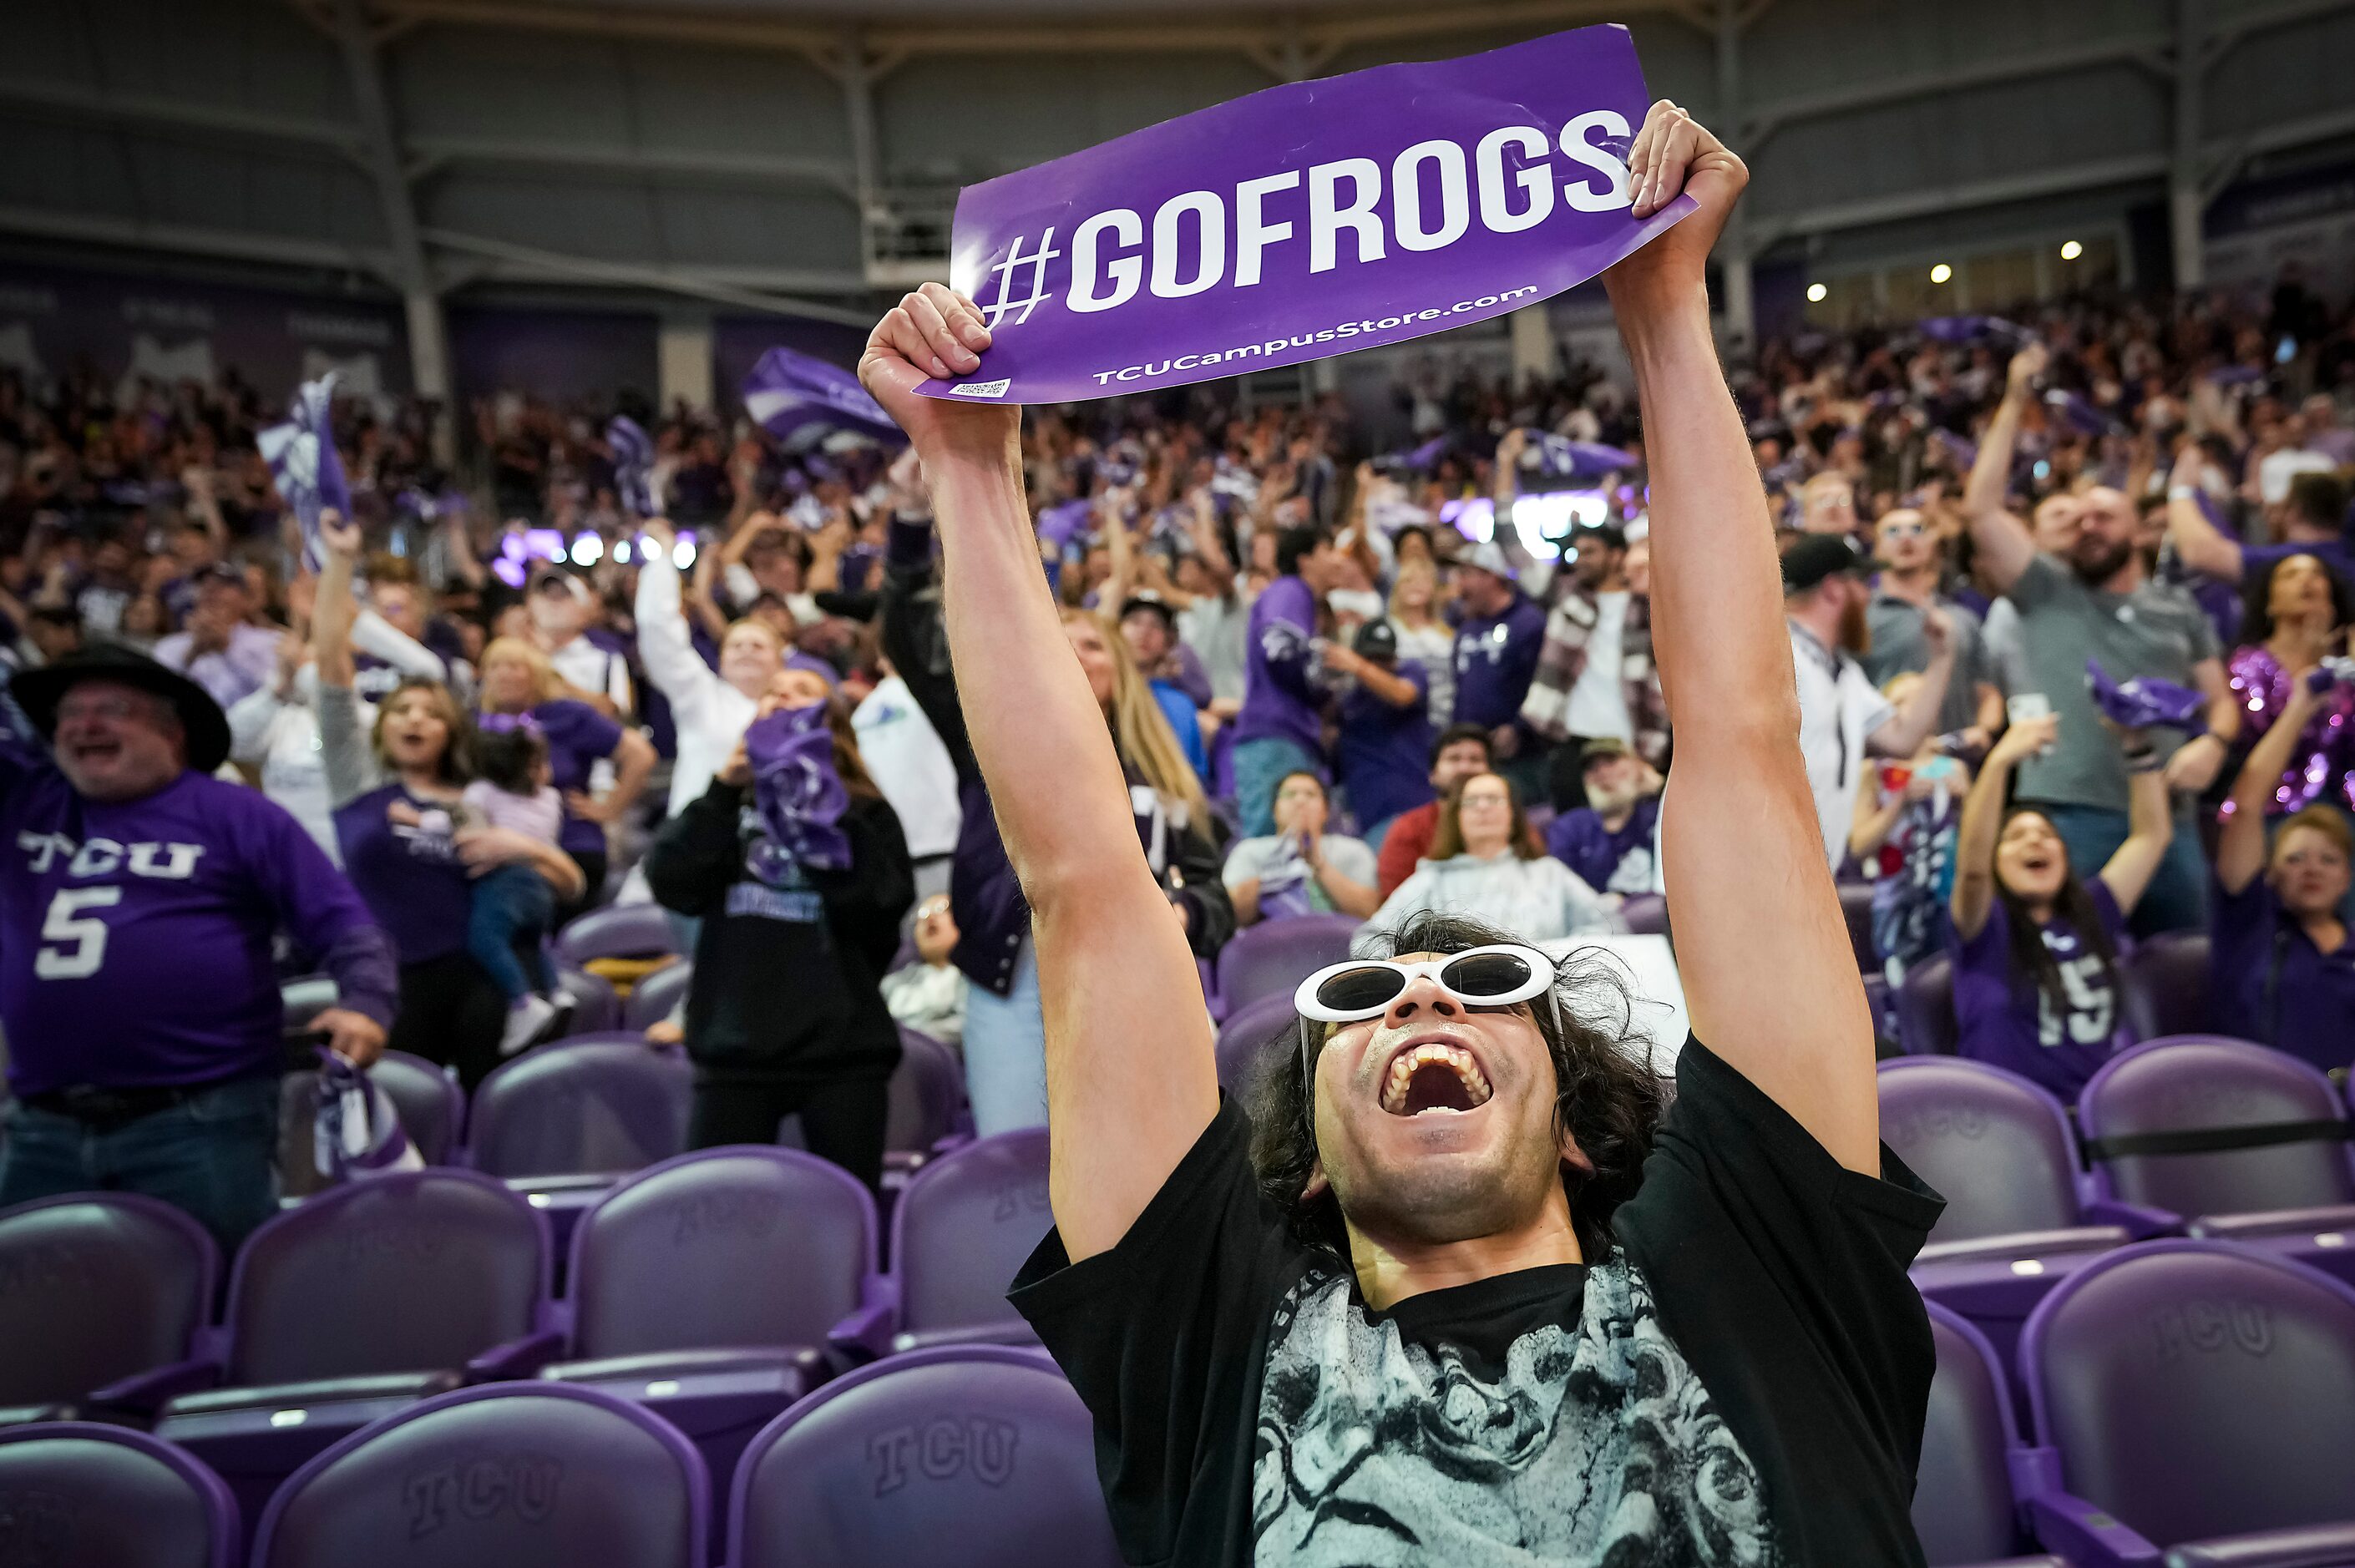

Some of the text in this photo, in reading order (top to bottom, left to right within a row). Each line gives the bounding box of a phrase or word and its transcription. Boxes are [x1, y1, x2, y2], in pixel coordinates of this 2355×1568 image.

[981, 109, 1634, 332] #GOFROGS
[1092, 285, 1539, 386] TCUCampusStore.com
[17, 829, 207, 880] TCU
[34, 885, 122, 980] 5
[402, 1449, 568, 1539] TCU
[866, 1411, 1020, 1498] TCU
